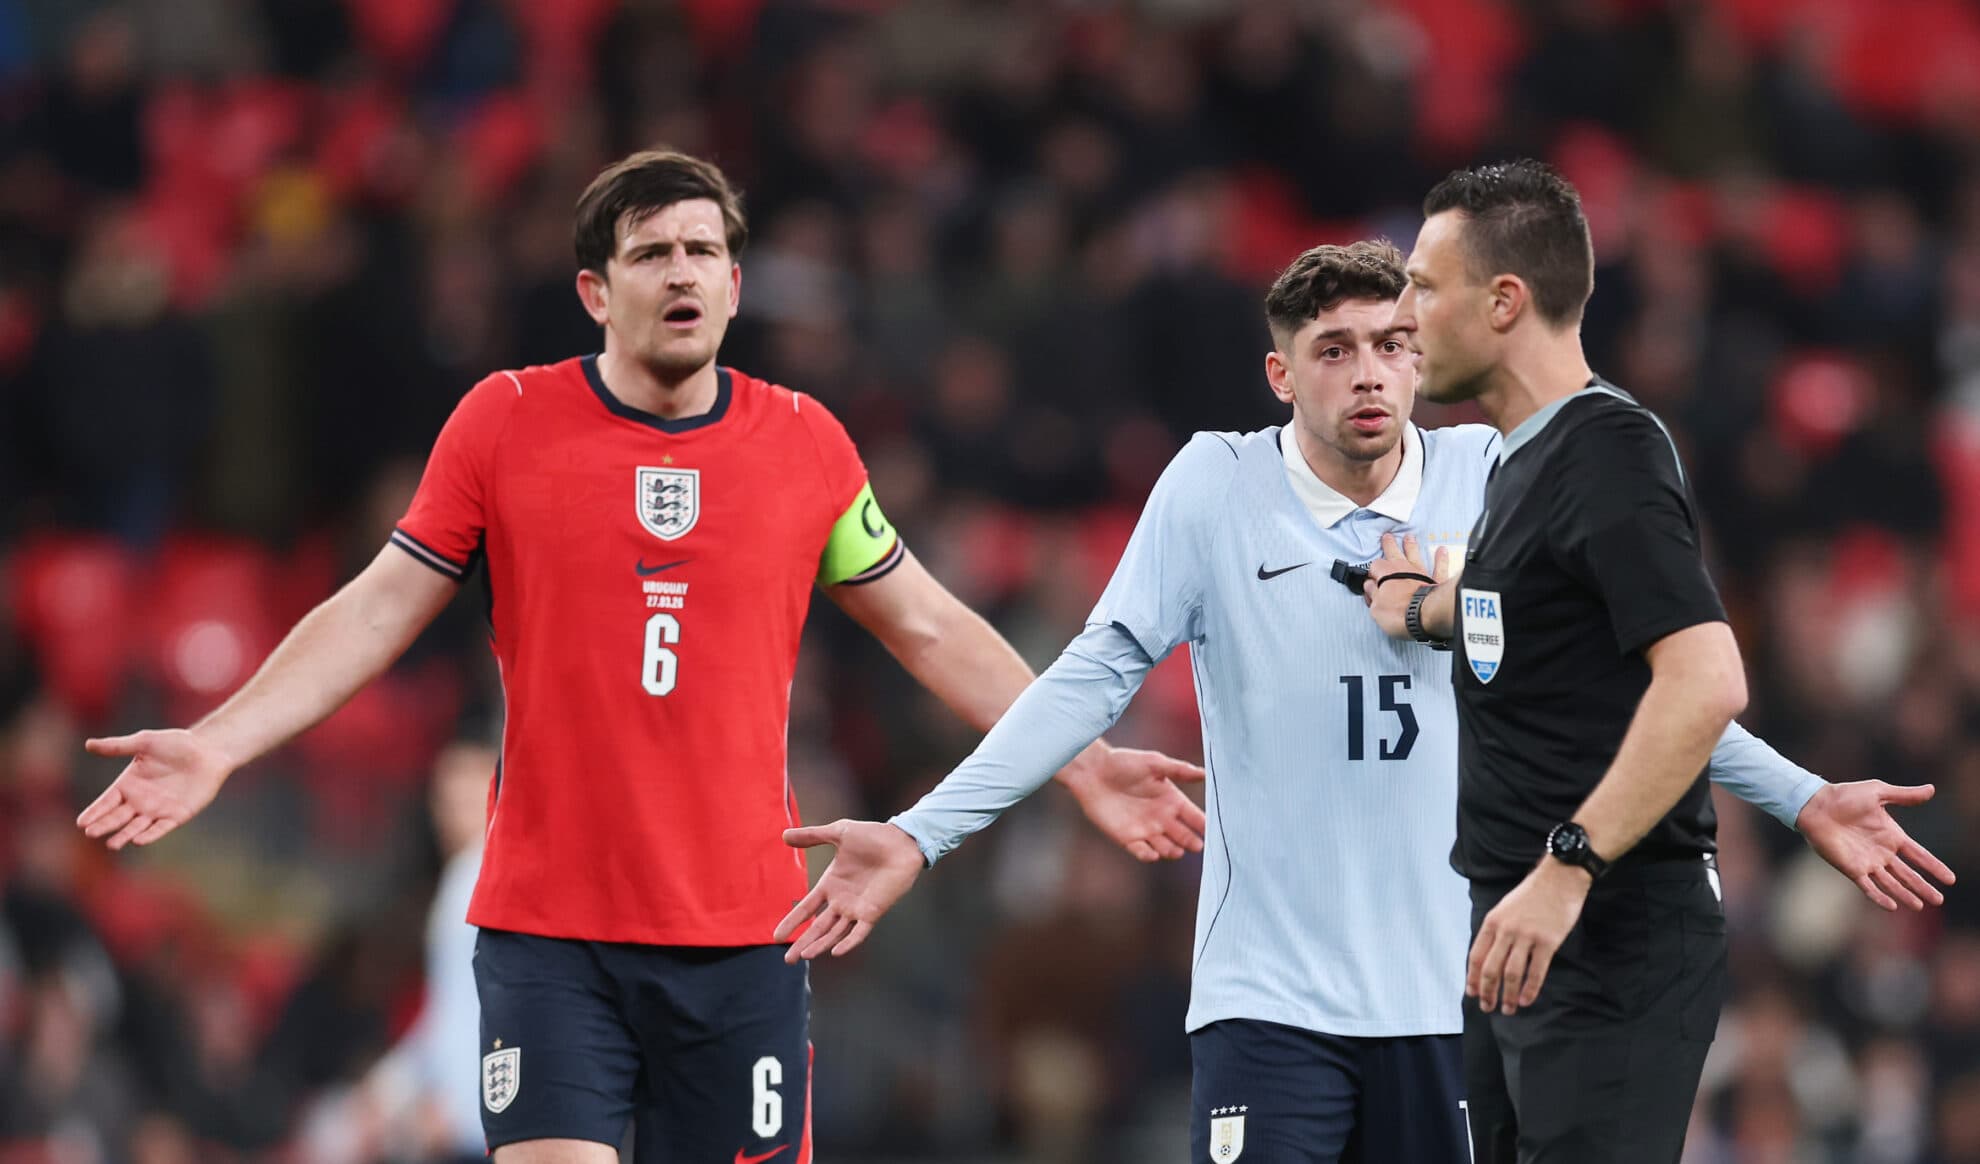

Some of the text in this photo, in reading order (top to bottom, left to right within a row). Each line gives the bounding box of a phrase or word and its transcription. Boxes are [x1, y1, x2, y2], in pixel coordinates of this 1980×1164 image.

[862, 498, 884, 538] C
[643, 581, 688, 595] URUGUAY
[1466, 597, 1497, 619] FIFA
[641, 612, 680, 696] 6
[1467, 632, 1500, 646] REFEREE
[1340, 675, 1419, 761] 15
[752, 1056, 783, 1138] 6
